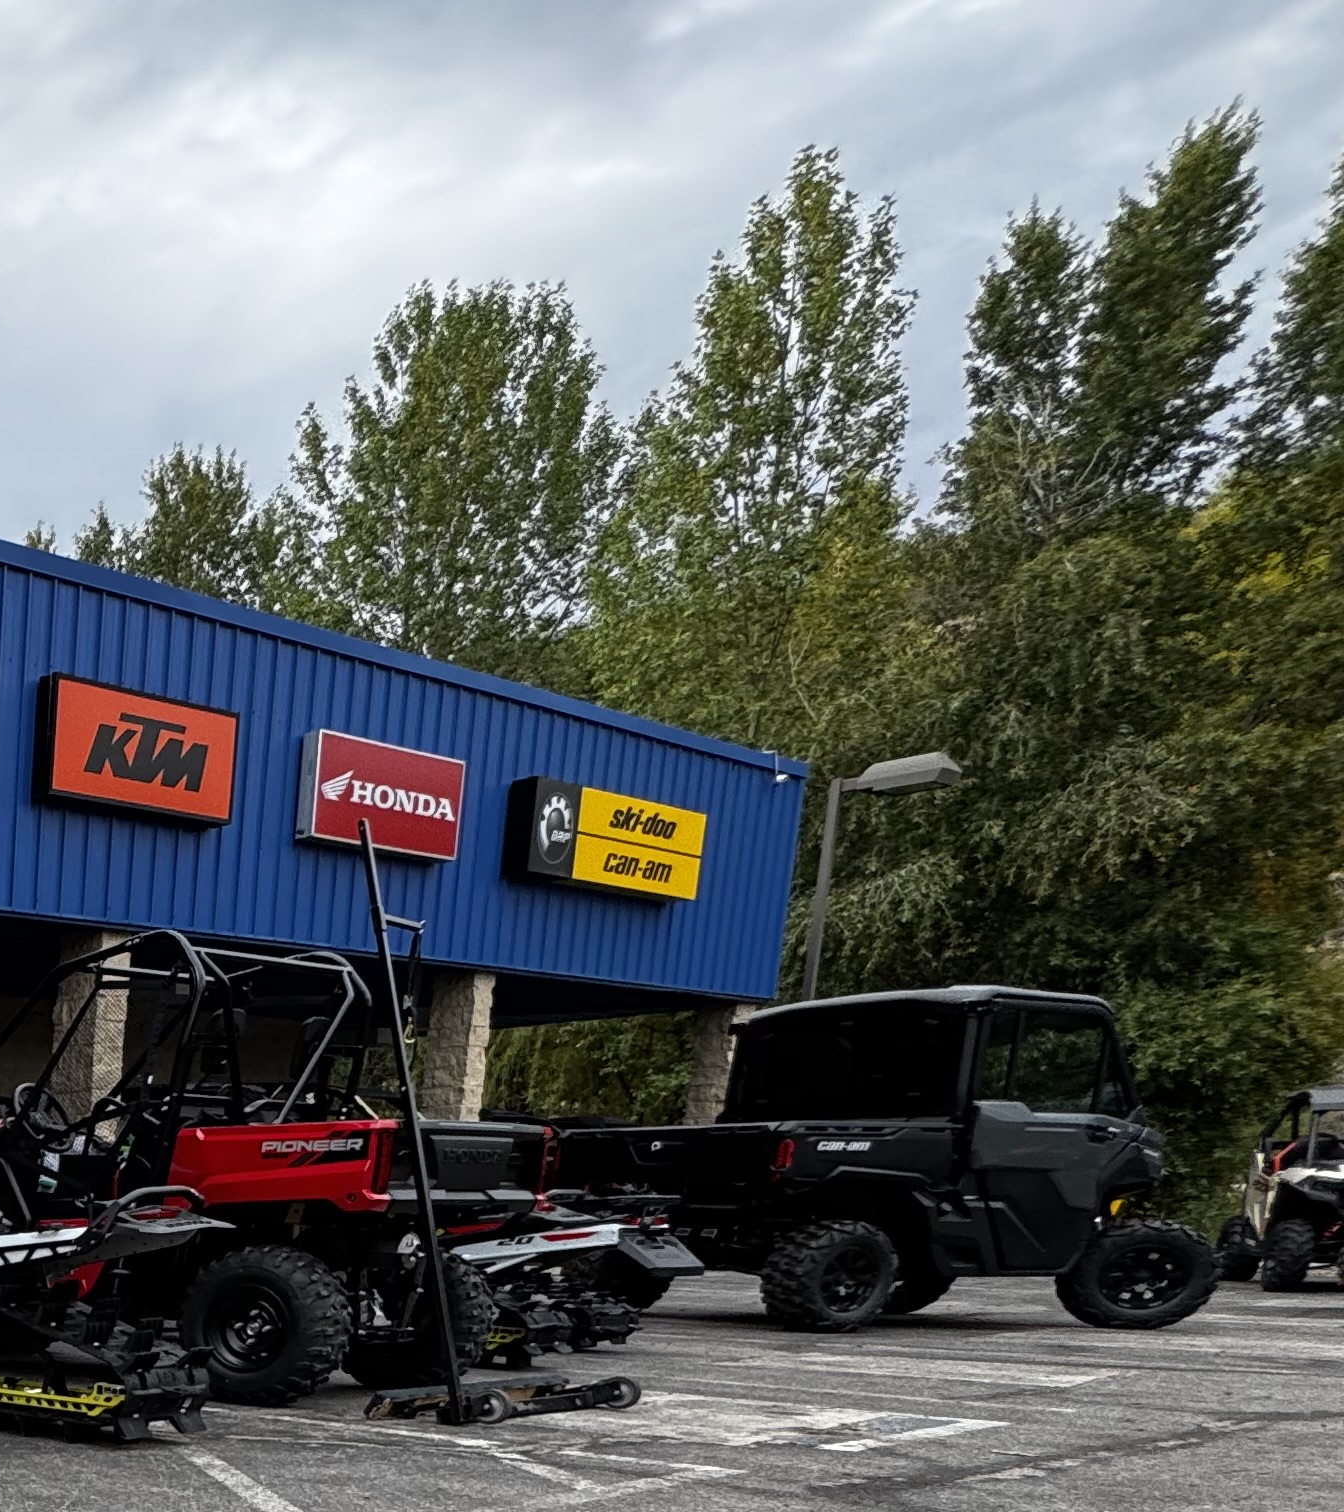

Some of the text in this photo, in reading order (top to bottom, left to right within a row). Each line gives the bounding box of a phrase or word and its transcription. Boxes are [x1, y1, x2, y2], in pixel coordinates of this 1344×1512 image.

[83, 712, 209, 793] KTM
[349, 779, 456, 822] HONDA
[608, 806, 677, 840] ski-doo
[602, 852, 673, 884] can-am
[261, 1138, 364, 1153] PIONEER
[816, 1141, 871, 1152] can-am
